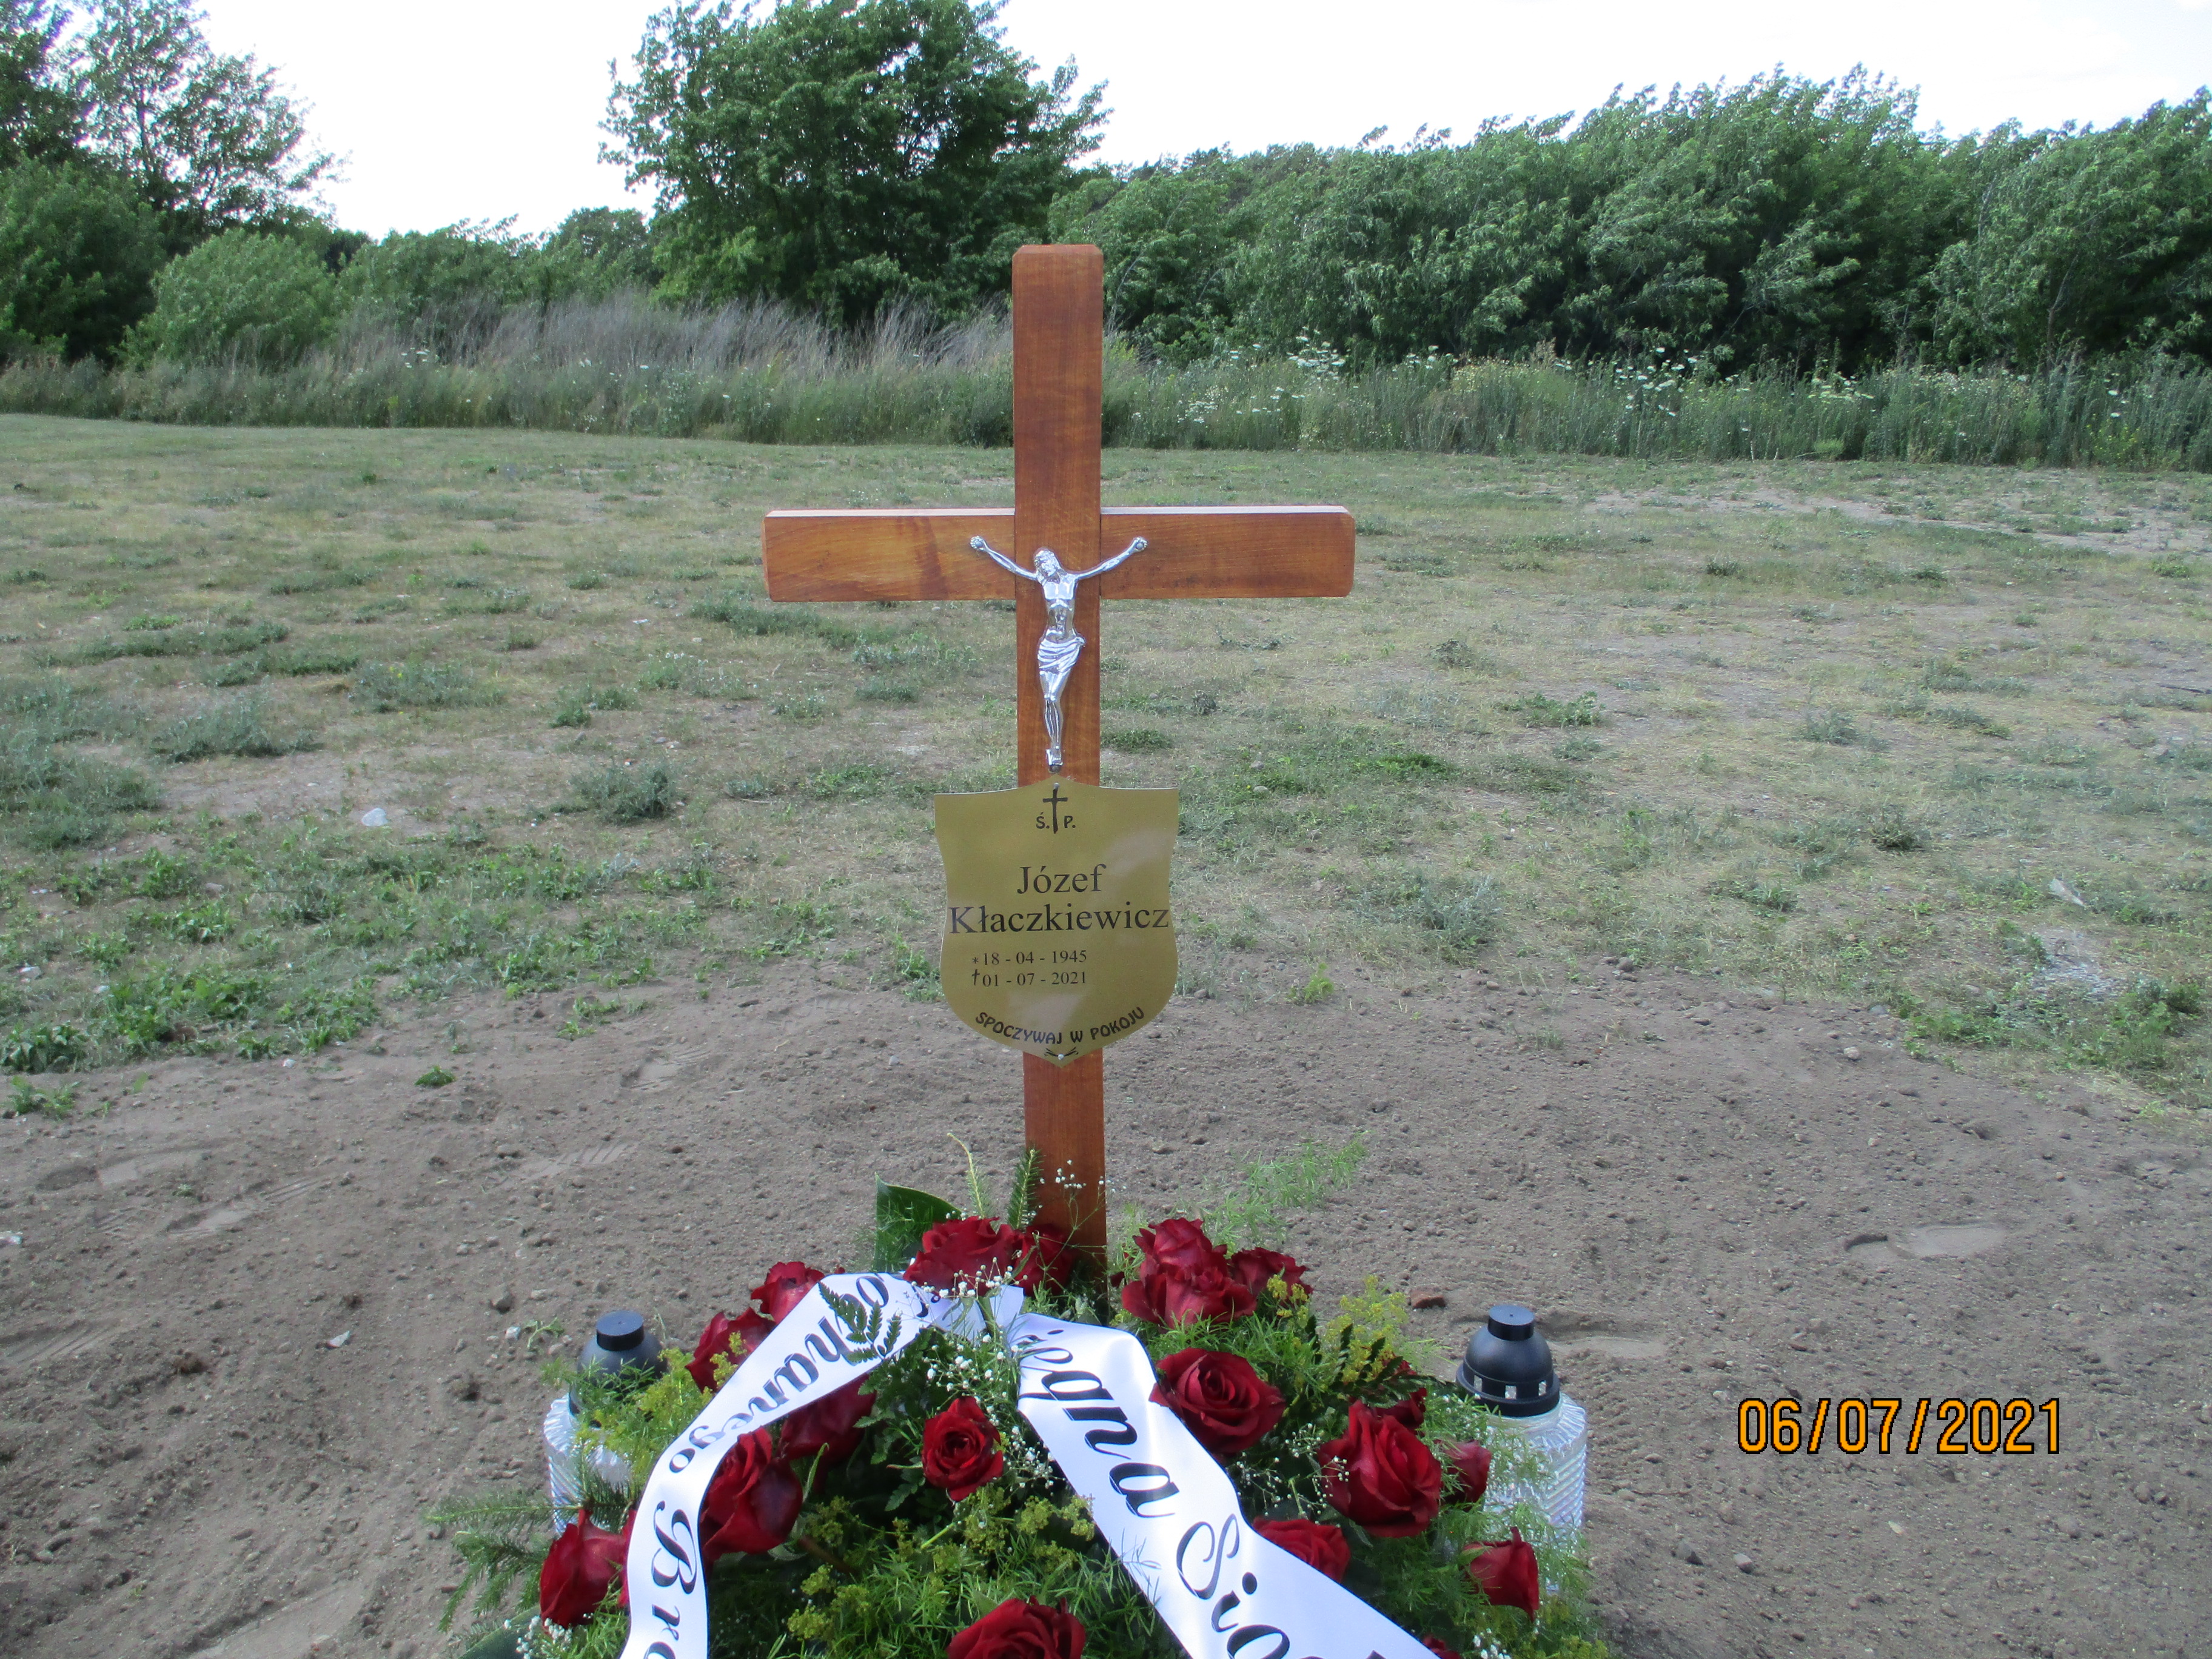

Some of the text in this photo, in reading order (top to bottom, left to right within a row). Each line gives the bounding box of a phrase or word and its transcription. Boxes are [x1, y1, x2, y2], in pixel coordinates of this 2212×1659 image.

[1036, 811, 1076, 830] Ś. P.
[1017, 863, 1107, 894] Józef
[949, 901, 1169, 934] Kłaczkiewicz
[975, 1007, 1145, 1045] SPOCZYWAJ W POKOJU
[669, 1273, 939, 1473] ohanego
